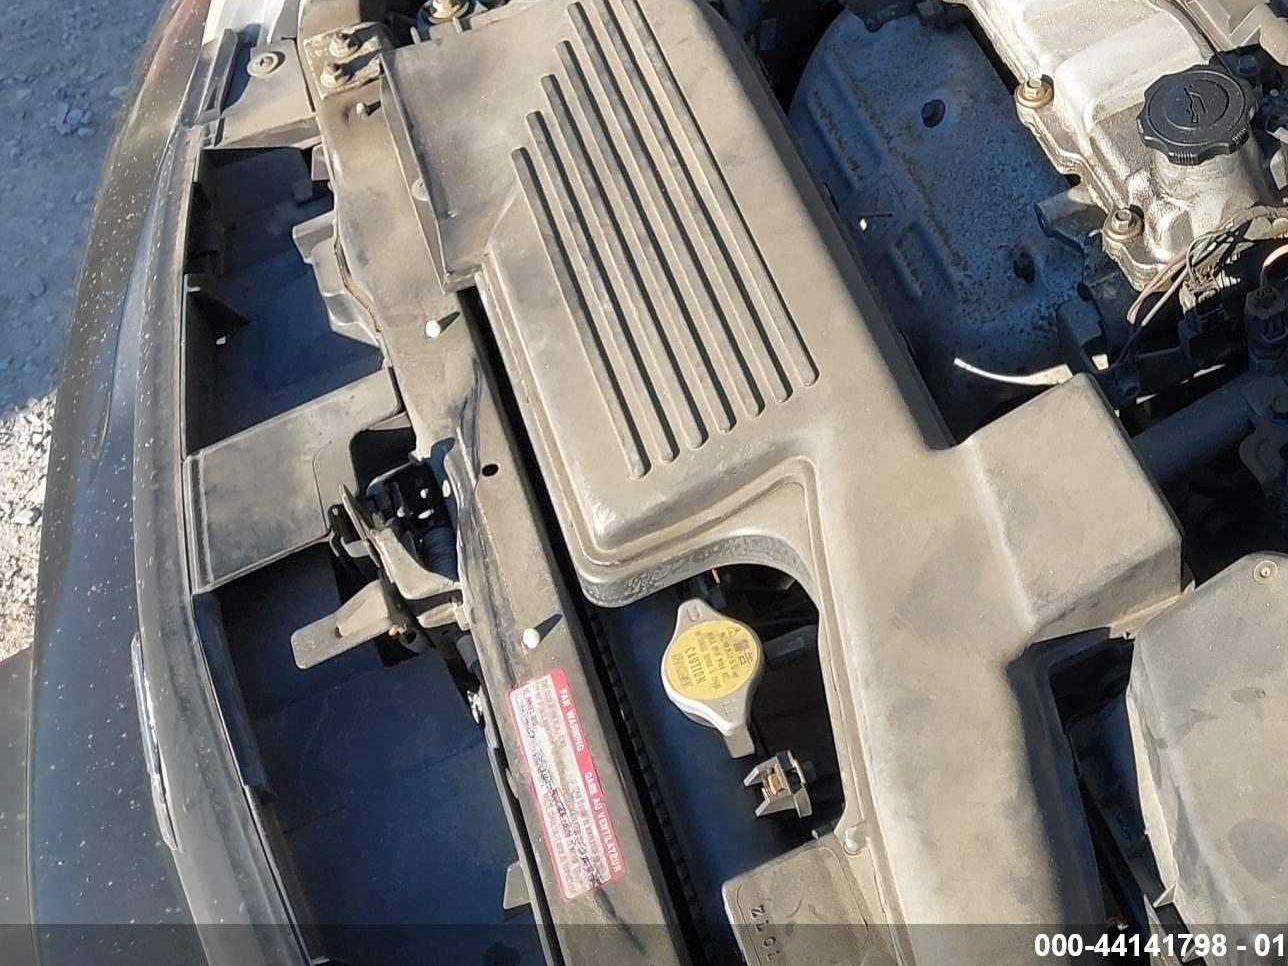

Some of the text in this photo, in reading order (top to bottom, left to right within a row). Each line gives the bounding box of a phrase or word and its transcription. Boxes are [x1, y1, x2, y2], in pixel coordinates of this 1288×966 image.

[683, 644, 707, 686] CAUTION
[558, 687, 571, 707] FAN
[565, 709, 585, 752] WARNING
[591, 796, 603, 811] AU
[596, 810, 622, 874] VENTILATEUR
